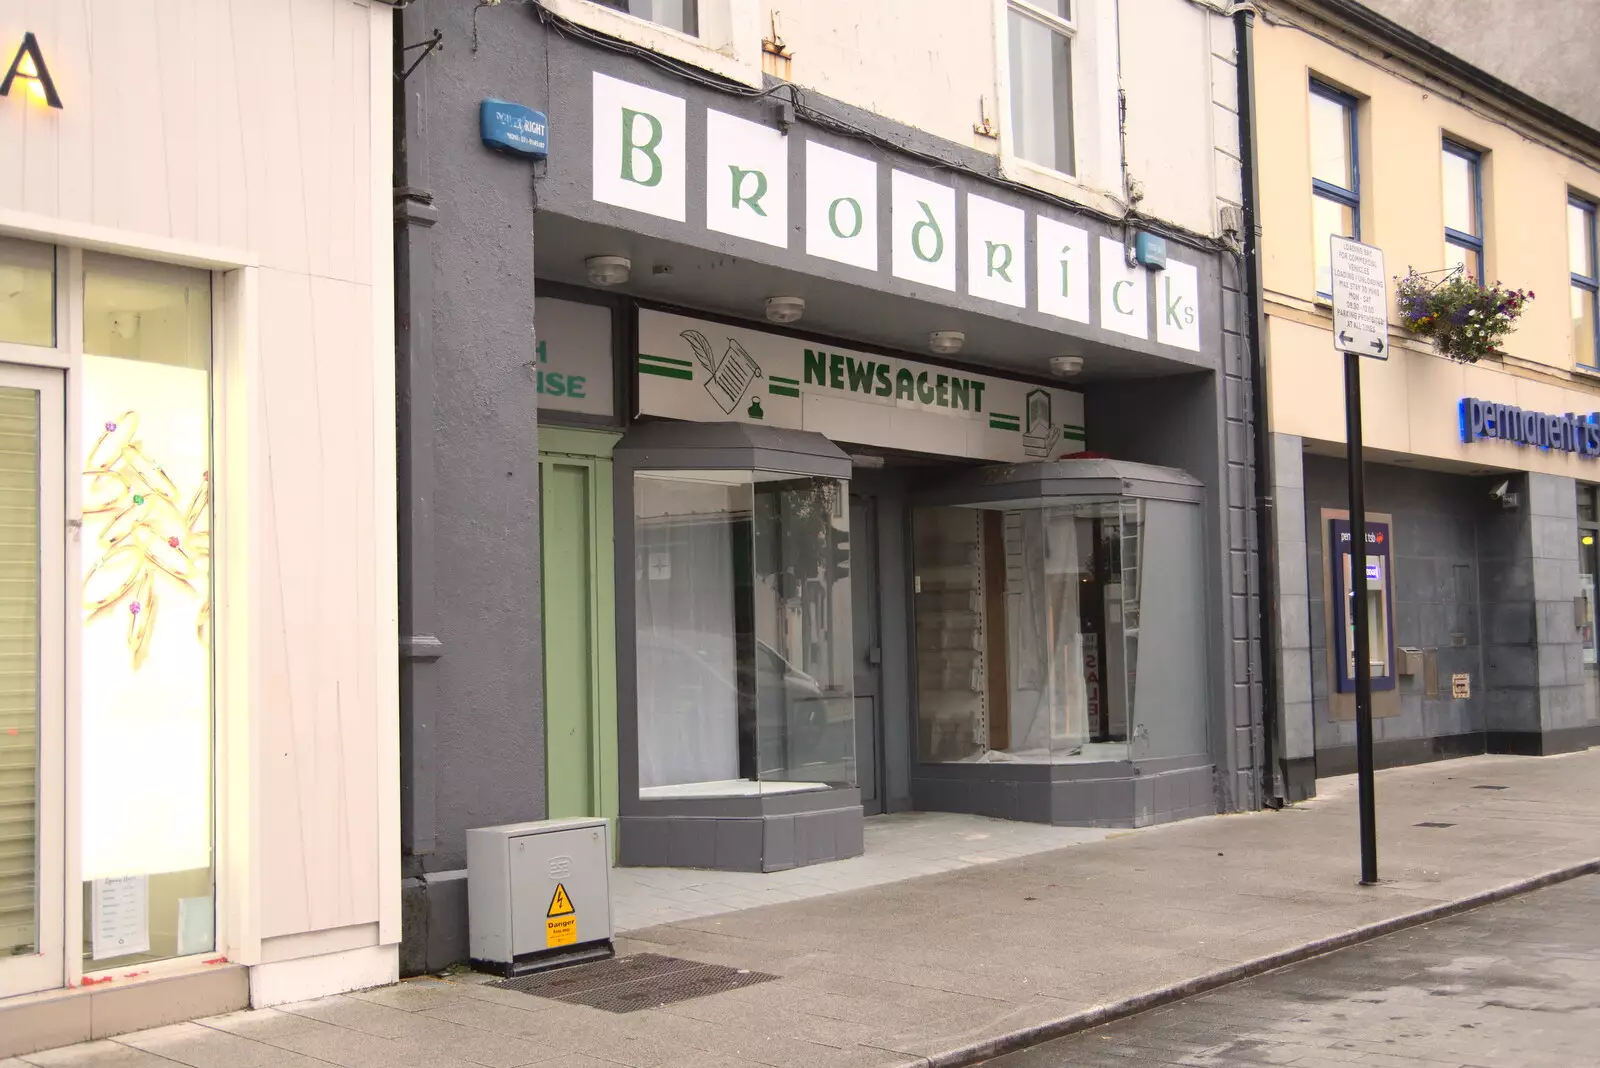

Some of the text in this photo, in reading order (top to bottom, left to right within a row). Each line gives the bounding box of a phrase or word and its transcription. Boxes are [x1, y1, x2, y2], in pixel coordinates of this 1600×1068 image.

[0, 32, 63, 109] A
[803, 348, 986, 413] NEWSAGENT
[1462, 397, 1580, 453] permanent
[548, 920, 575, 929] Danger
